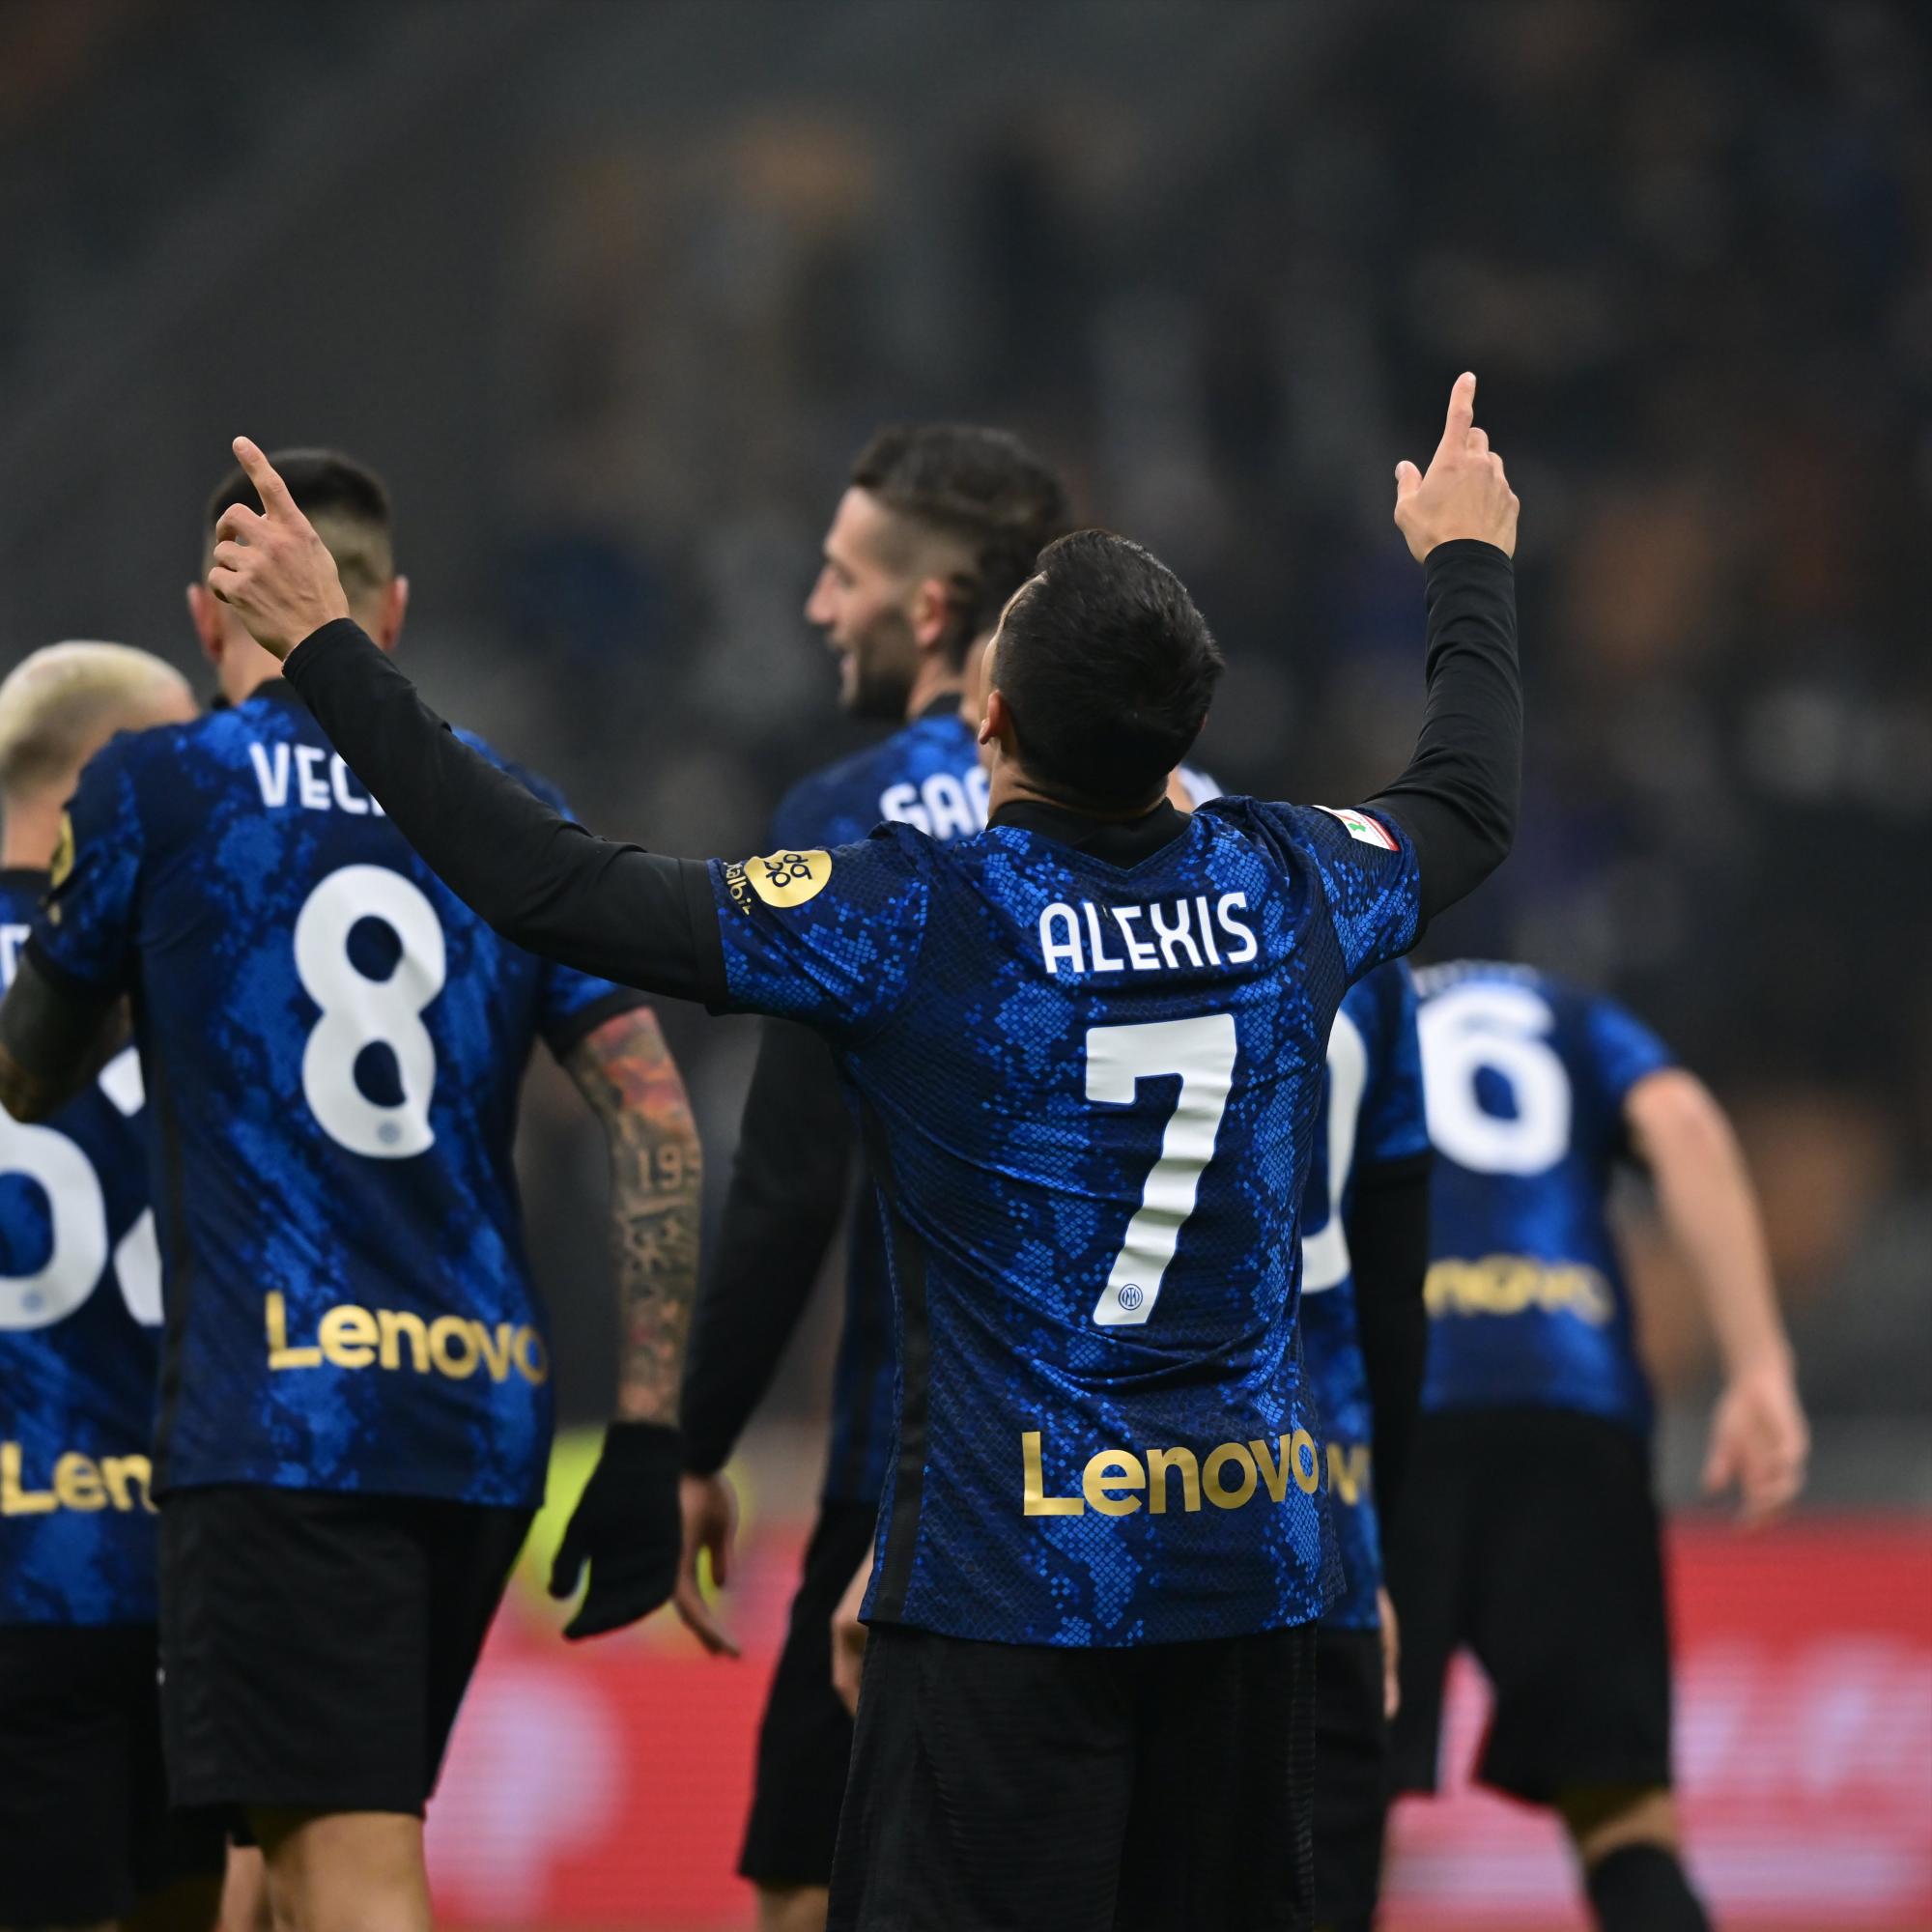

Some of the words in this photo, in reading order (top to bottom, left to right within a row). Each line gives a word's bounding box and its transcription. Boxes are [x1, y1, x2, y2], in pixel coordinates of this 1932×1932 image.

[248, 741, 387, 816] VEC
[1038, 892, 1259, 975] ALEXIS
[295, 865, 446, 1159] 8
[1416, 980, 1573, 1177] 6
[1084, 1012, 1237, 1327] 7
[265, 1291, 548, 1385] Lenovo
[1021, 1428, 1321, 1517] Lenovo
